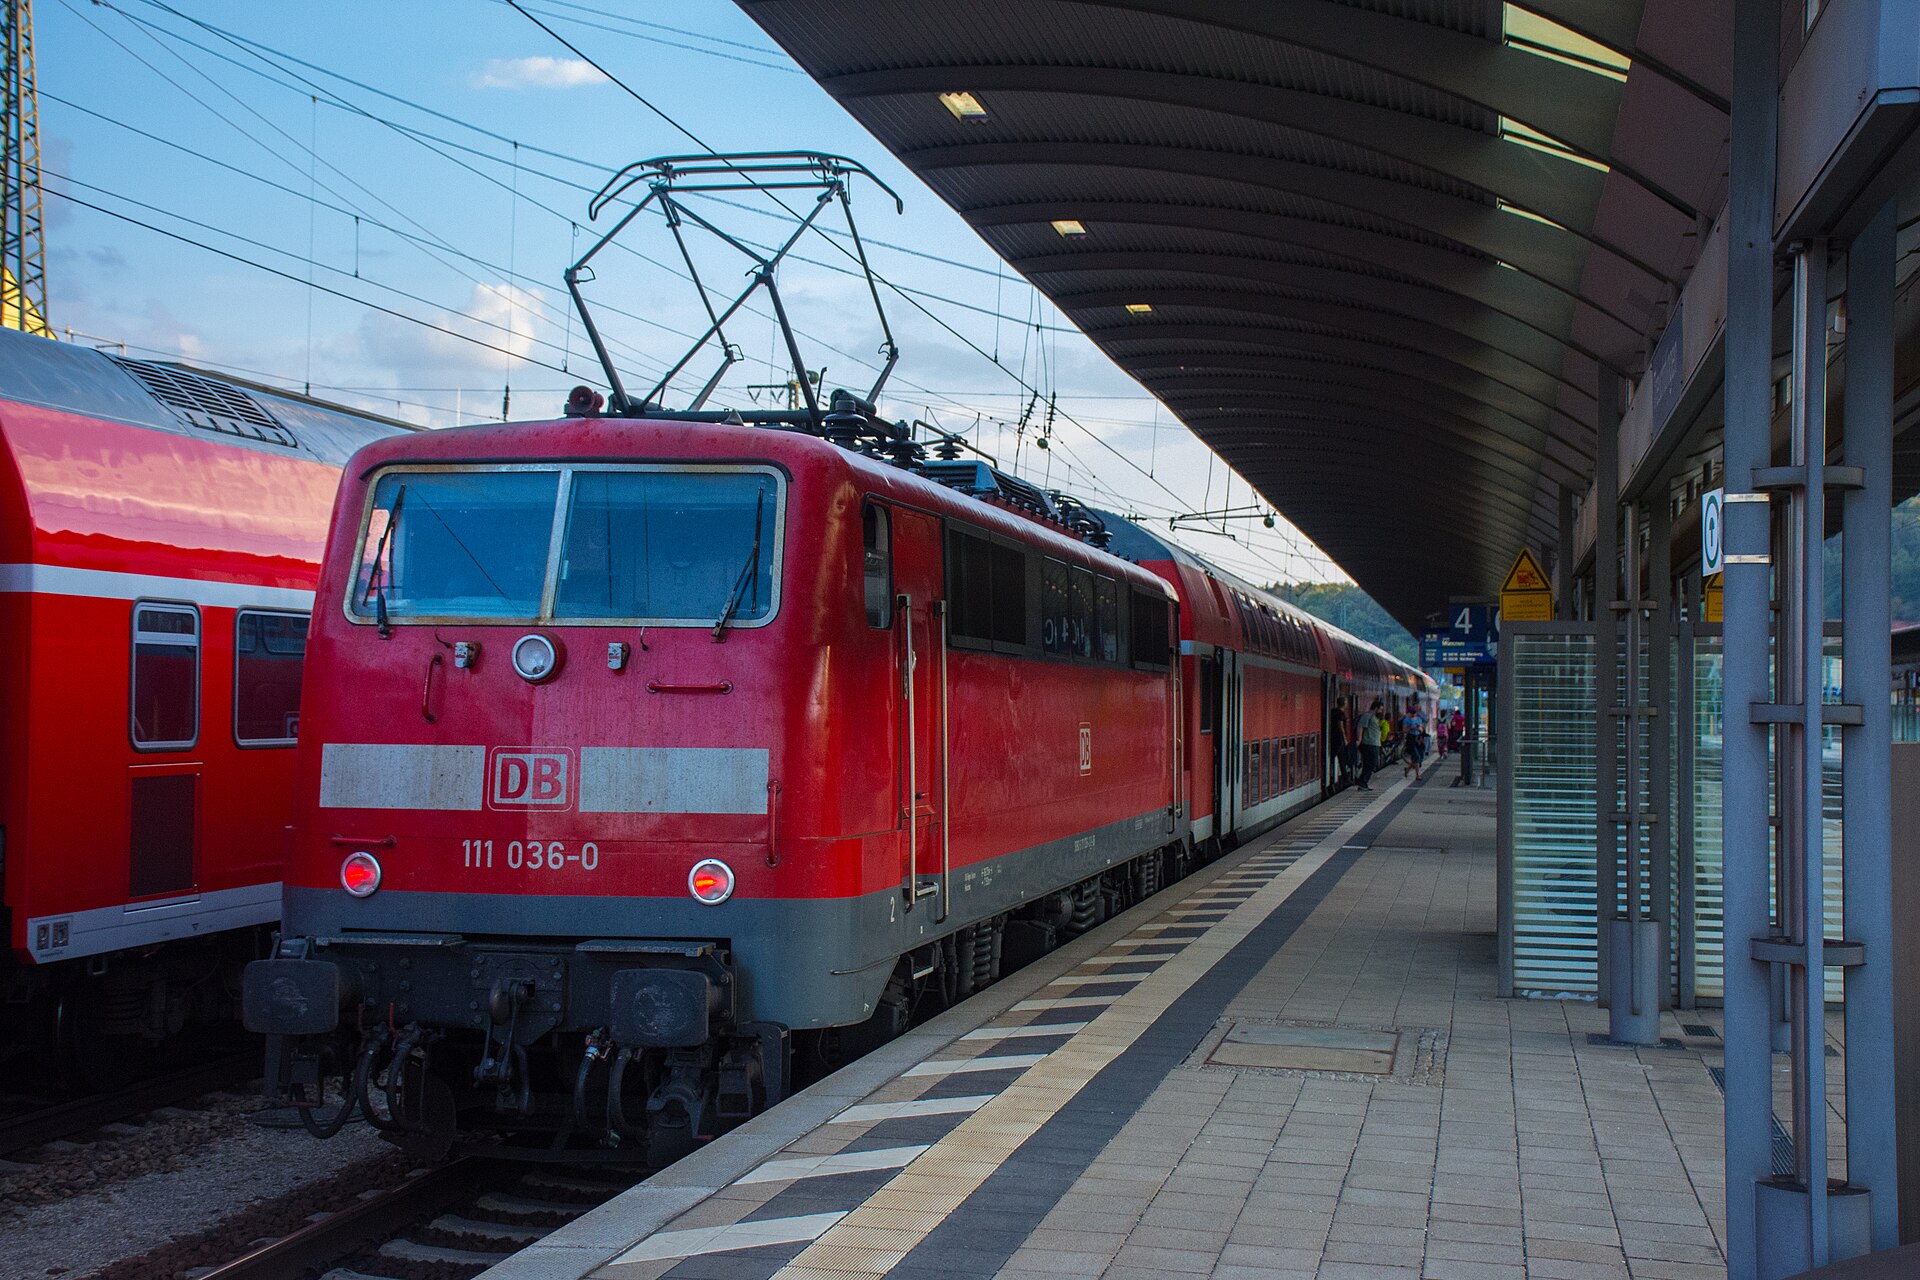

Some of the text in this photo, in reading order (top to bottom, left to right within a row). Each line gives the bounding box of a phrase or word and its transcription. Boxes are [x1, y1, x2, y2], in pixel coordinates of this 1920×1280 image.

[1454, 607, 1472, 634] 4
[1080, 730, 1091, 767] DB
[498, 756, 564, 800] DB
[462, 839, 599, 871] 111 036-0
